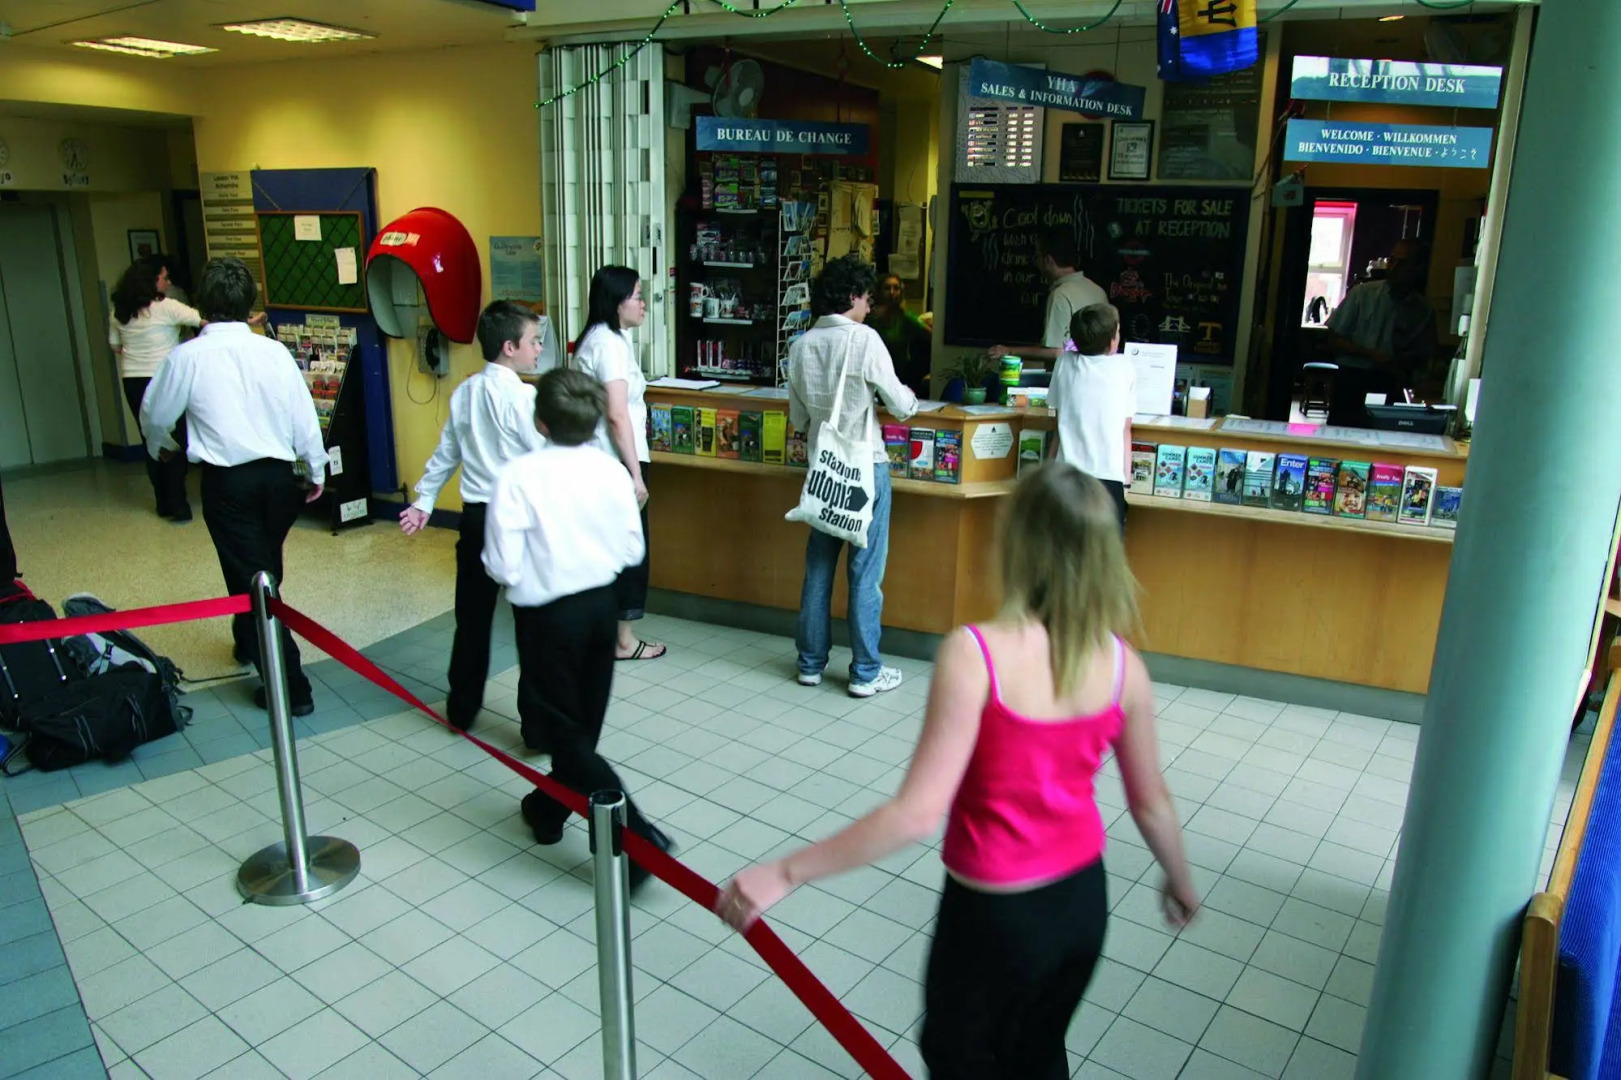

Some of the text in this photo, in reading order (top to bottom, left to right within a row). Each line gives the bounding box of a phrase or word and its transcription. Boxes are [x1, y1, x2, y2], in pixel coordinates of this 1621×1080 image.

[1046, 75, 1077, 93] YHA
[1329, 73, 1466, 94] RECEPTION DESK
[980, 82, 1133, 116] SALES & INFORMATION DESK
[717, 128, 853, 145] BUREAU DE CHANGE
[1321, 129, 1458, 145] WELCOME WILLKOMMEN
[1298, 142, 1364, 155] BIENVENIDO
[1372, 146, 1432, 158] BIENVENUE
[1002, 204, 1073, 229] Cool down
[1116, 197, 1234, 217] TICKETS FOR SALE
[1134, 220, 1232, 239] AT RECEPTION
[1280, 458, 1305, 468] Enter
[807, 470, 856, 510] utopia
[819, 508, 863, 532] station
